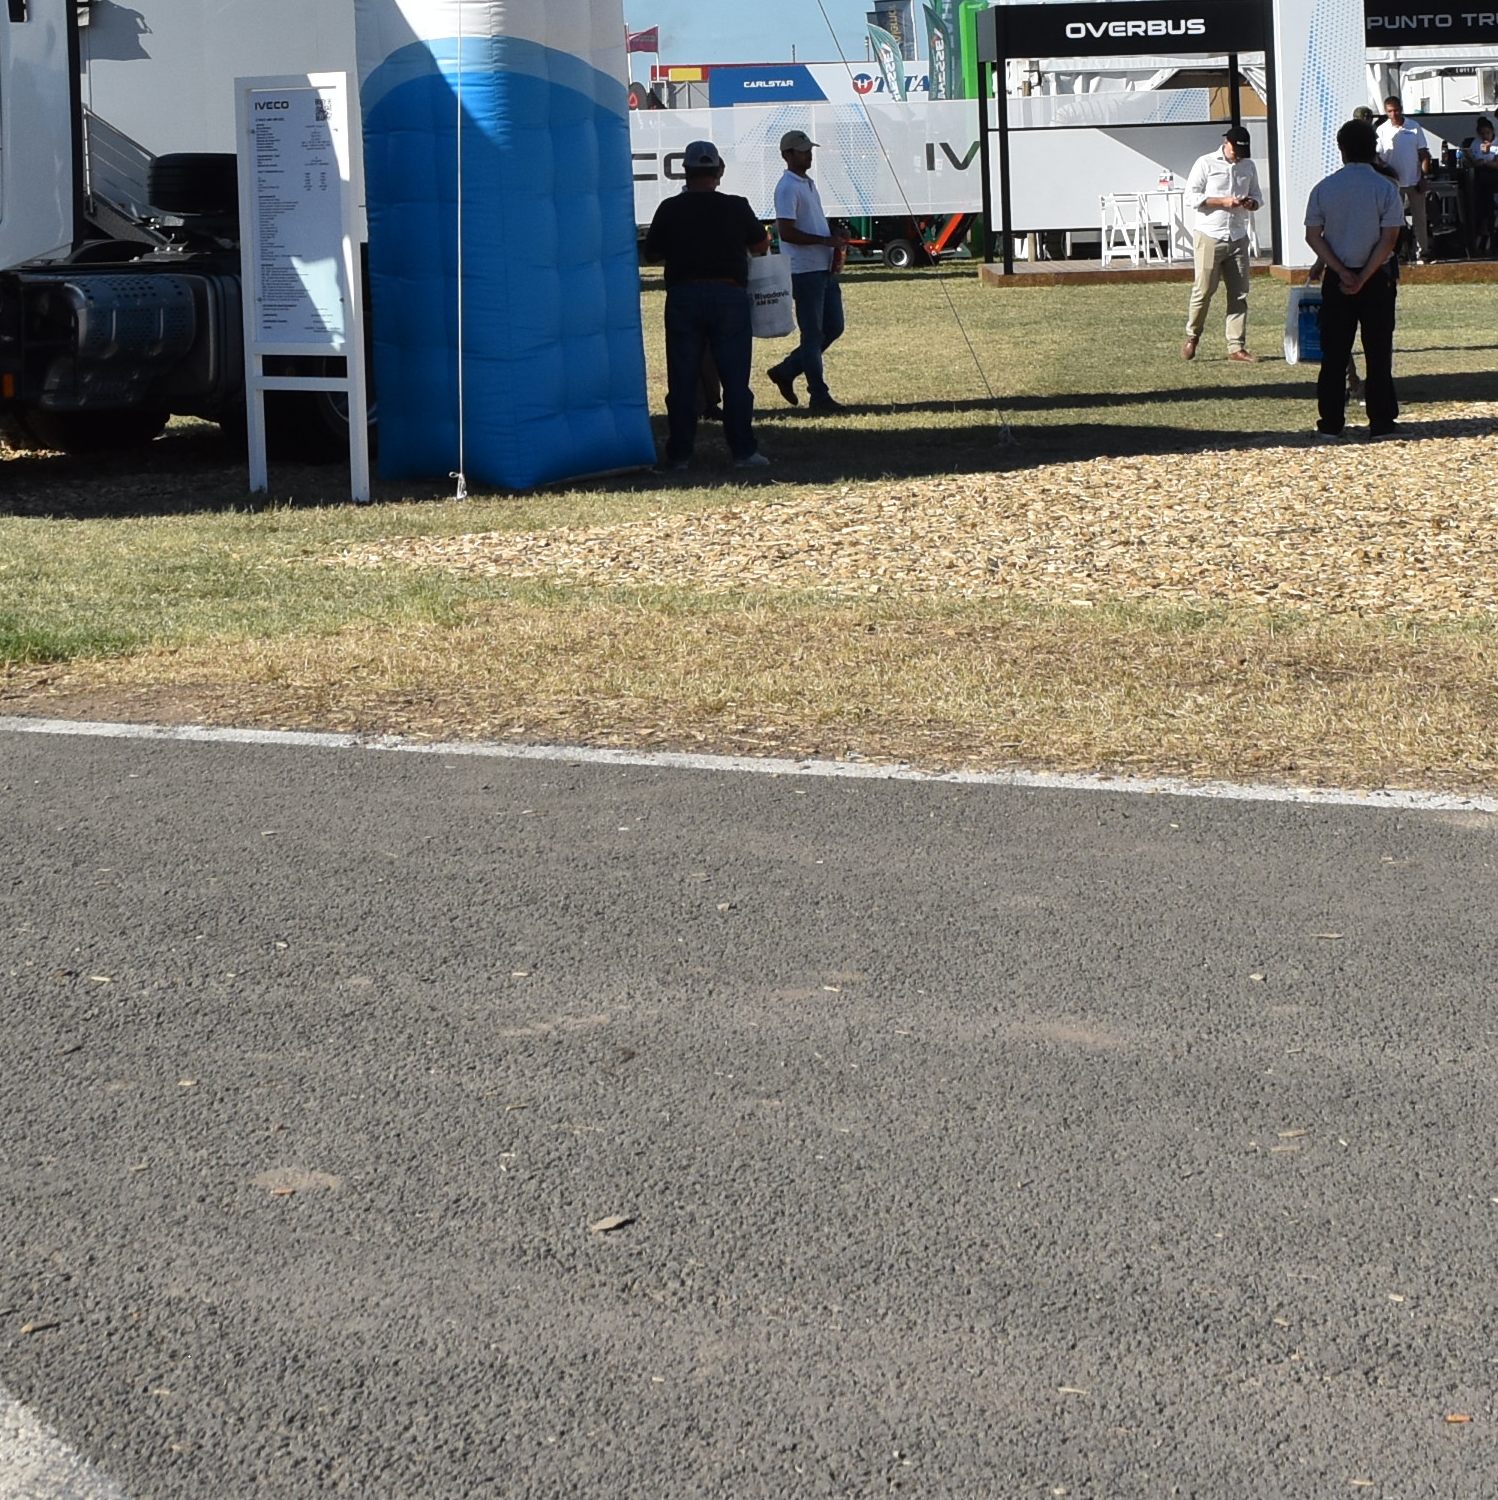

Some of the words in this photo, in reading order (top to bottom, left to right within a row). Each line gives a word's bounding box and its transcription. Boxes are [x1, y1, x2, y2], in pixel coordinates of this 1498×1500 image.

[1065, 18, 1206, 39] OVERBUS
[1367, 14, 1452, 29] PUNTO
[743, 79, 794, 88] CARLSTAR
[255, 101, 289, 110] IVECO
[925, 140, 981, 171] IV
